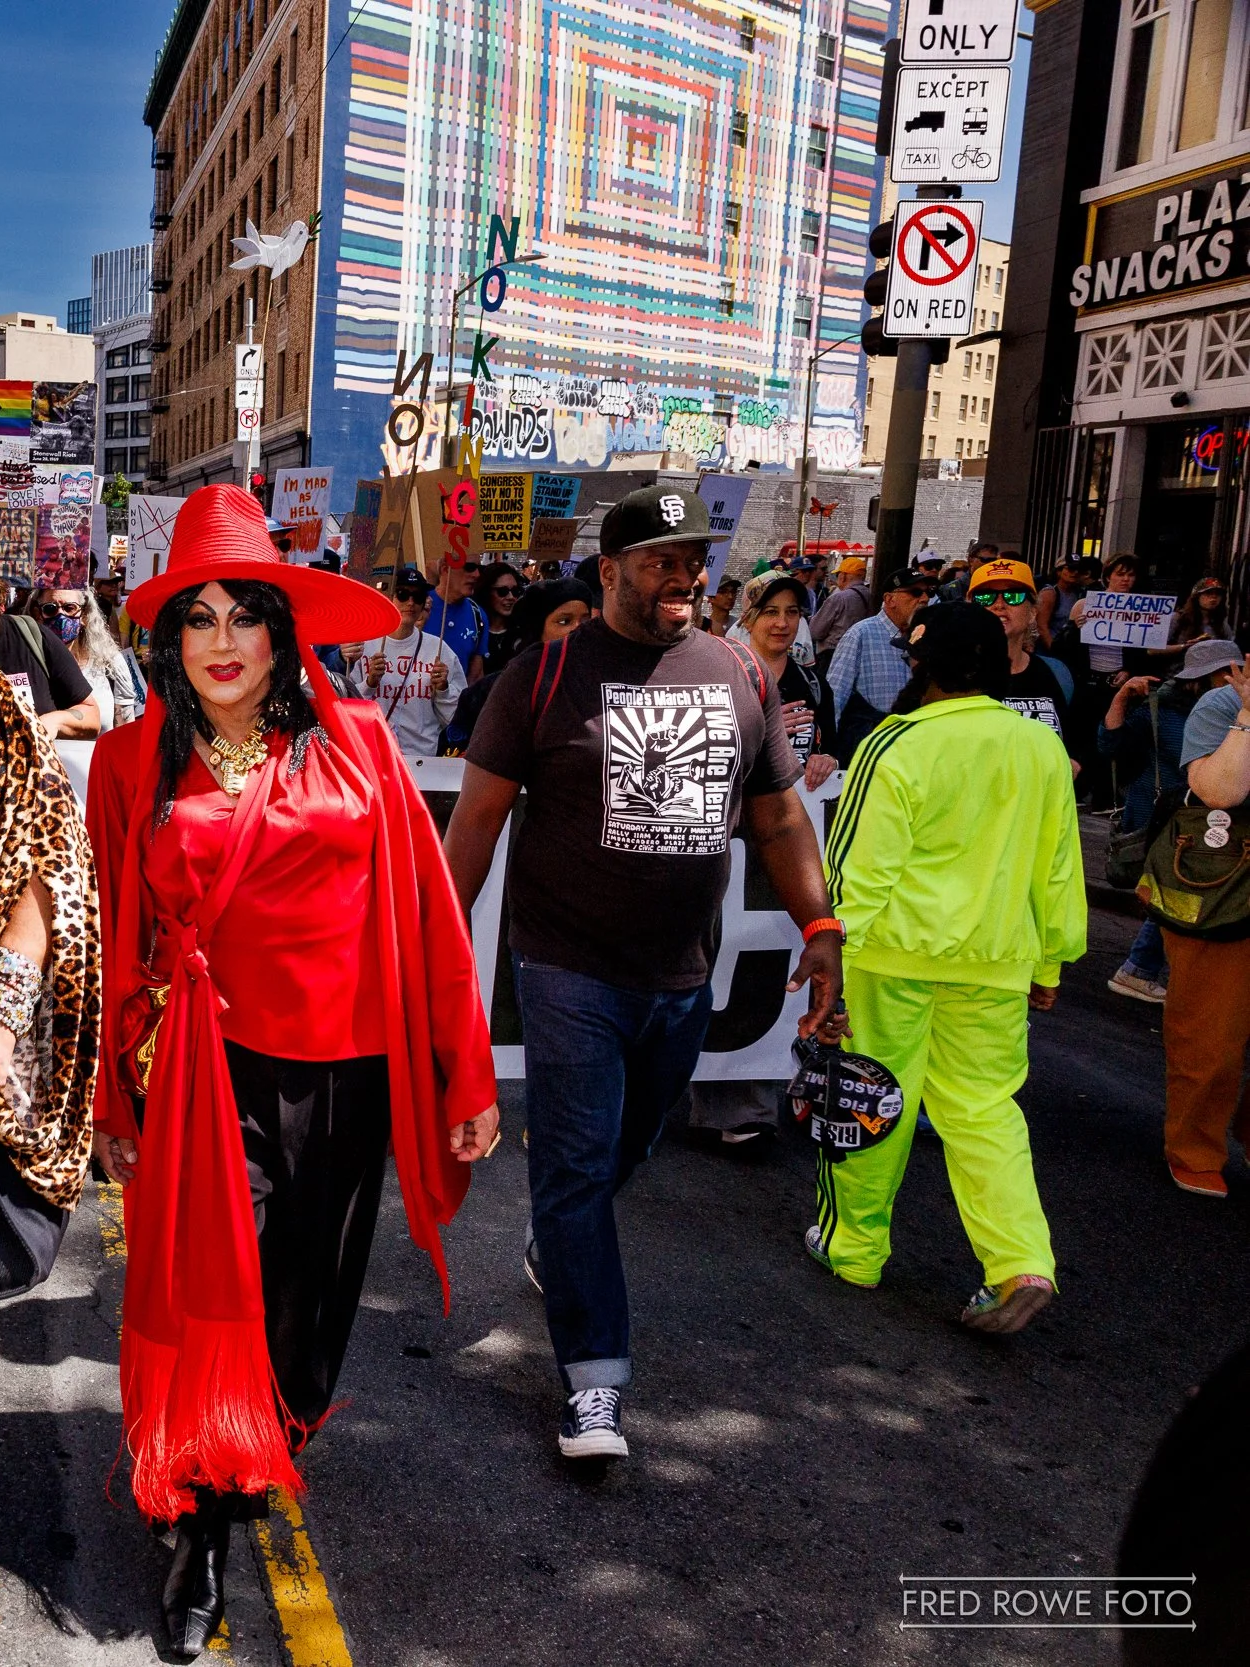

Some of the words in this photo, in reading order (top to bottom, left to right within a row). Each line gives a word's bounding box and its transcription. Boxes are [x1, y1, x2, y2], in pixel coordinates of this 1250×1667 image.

[919, 24, 998, 50] ONLY
[918, 80, 989, 98] EXCEPT
[906, 152, 938, 165] TAXI
[1070, 230, 1234, 307] SNACKS
[894, 299, 918, 318] ON
[928, 300, 966, 319] RED
[283, 477, 298, 492] I'M
[305, 476, 328, 490] MAD
[480, 475, 525, 487] CONGRESS:
[538, 476, 564, 487] MAY
[7, 490, 30, 501] LOVE
[34, 488, 43, 498] IS
[299, 492, 311, 503] AS
[480, 487, 496, 498] SAY
[499, 487, 511, 498] NO
[514, 487, 524, 498] TO
[535, 486, 561, 496] STAND
[563, 487, 574, 497] UP
[8, 497, 44, 508] LOUDER
[480, 499, 524, 512] BILLIONS
[533, 496, 543, 505] TO
[545, 496, 571, 507] TRUMP
[712, 501, 725, 513] NO
[290, 505, 318, 520] HELL
[493, 513, 523, 522] TRUMP'S
[531, 507, 566, 518] GENERAL
[659, 495, 685, 527] SF
[539, 523, 572, 536] DRAFT
[484, 532, 522, 541] RAN
[1116, 611, 1141, 622] FIND
[1143, 612, 1161, 624] THE
[1093, 620, 1153, 646] CLIT
[397, 655, 434, 677] The
[605, 688, 652, 706] People's
[654, 691, 692, 707] March
[703, 688, 730, 708] Rally
[704, 710, 734, 741] We
[707, 746, 736, 776] Are
[704, 781, 729, 823] Here
[607, 828, 630, 838] RALLY
[607, 835, 660, 845] EMBARCADERO
